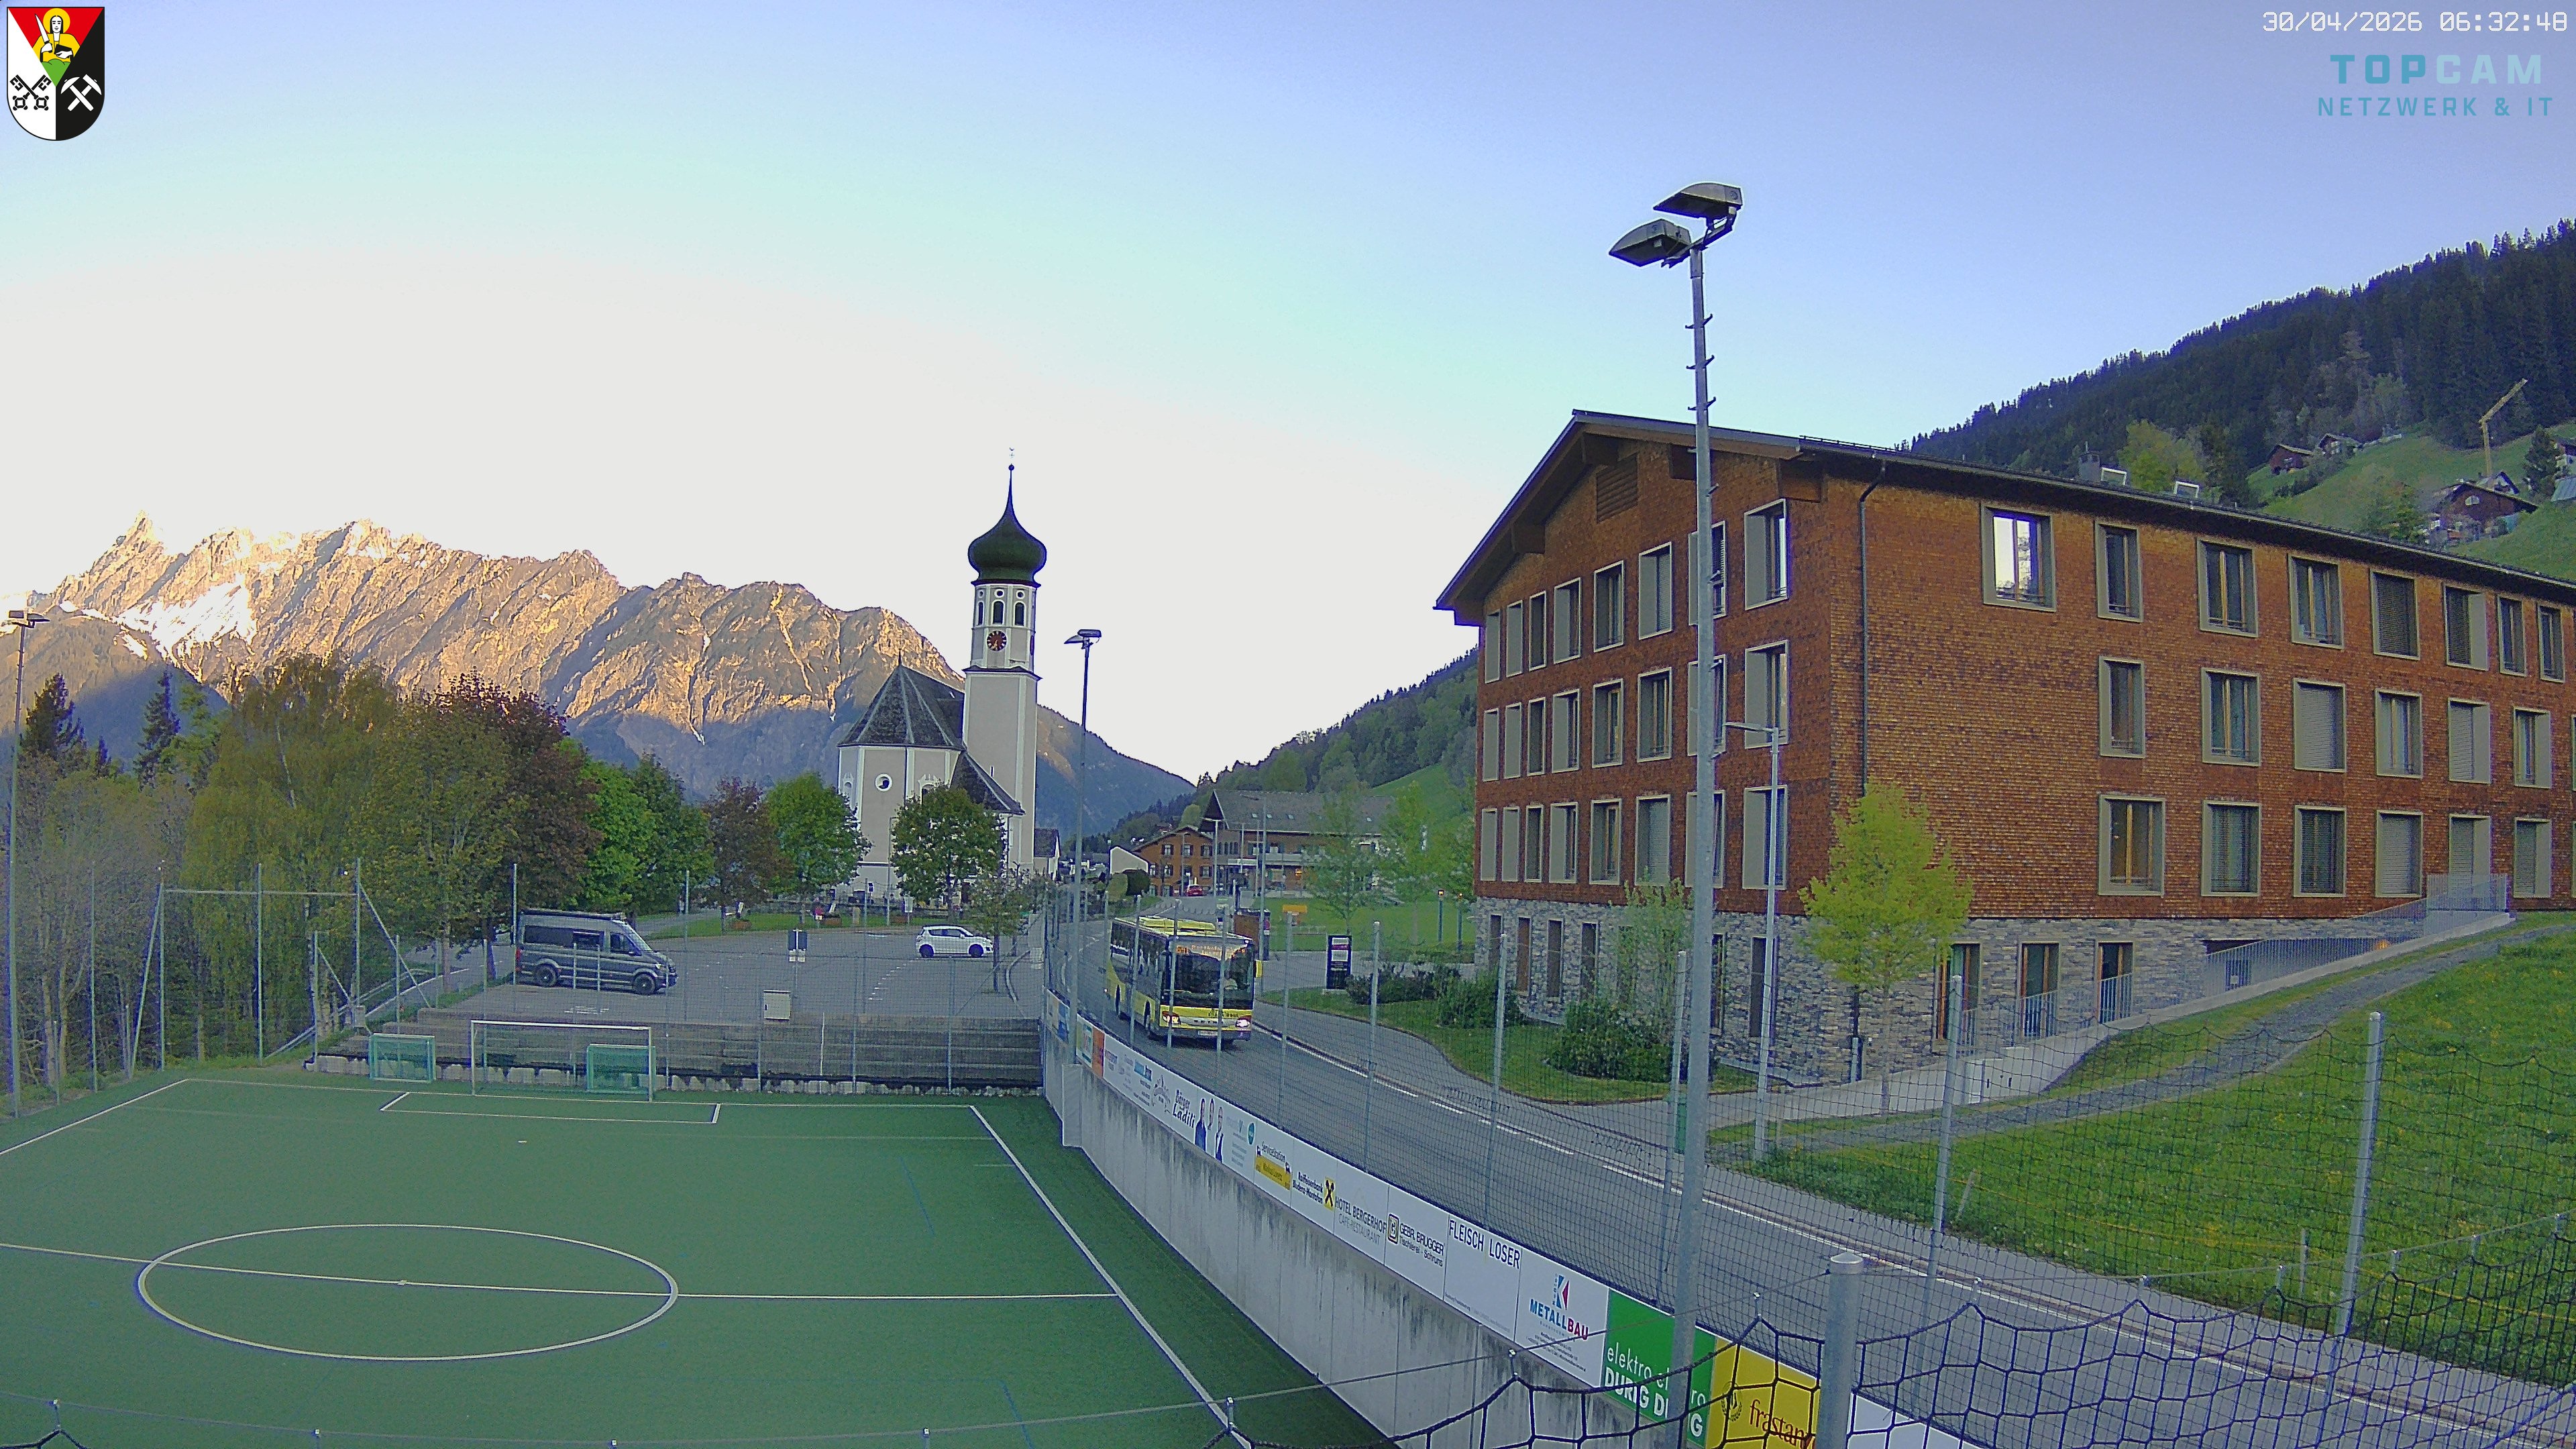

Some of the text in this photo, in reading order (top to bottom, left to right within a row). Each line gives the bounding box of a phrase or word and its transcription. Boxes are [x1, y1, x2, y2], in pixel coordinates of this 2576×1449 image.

[1298, 1171, 1323, 1193] Raiffeisenbank
[1335, 1196, 1387, 1234] HOTEL BERGERHOF
[1399, 1236, 1420, 1254] Tischlerei
[1424, 1249, 1443, 1267] Schruns
[1400, 1224, 1444, 1256] GEBR. BRUGGER
[1449, 1220, 1521, 1269] FLEISCH LOSER
[1529, 1299, 1589, 1340] METALLBAU
[1607, 1342, 1652, 1380] elektro
